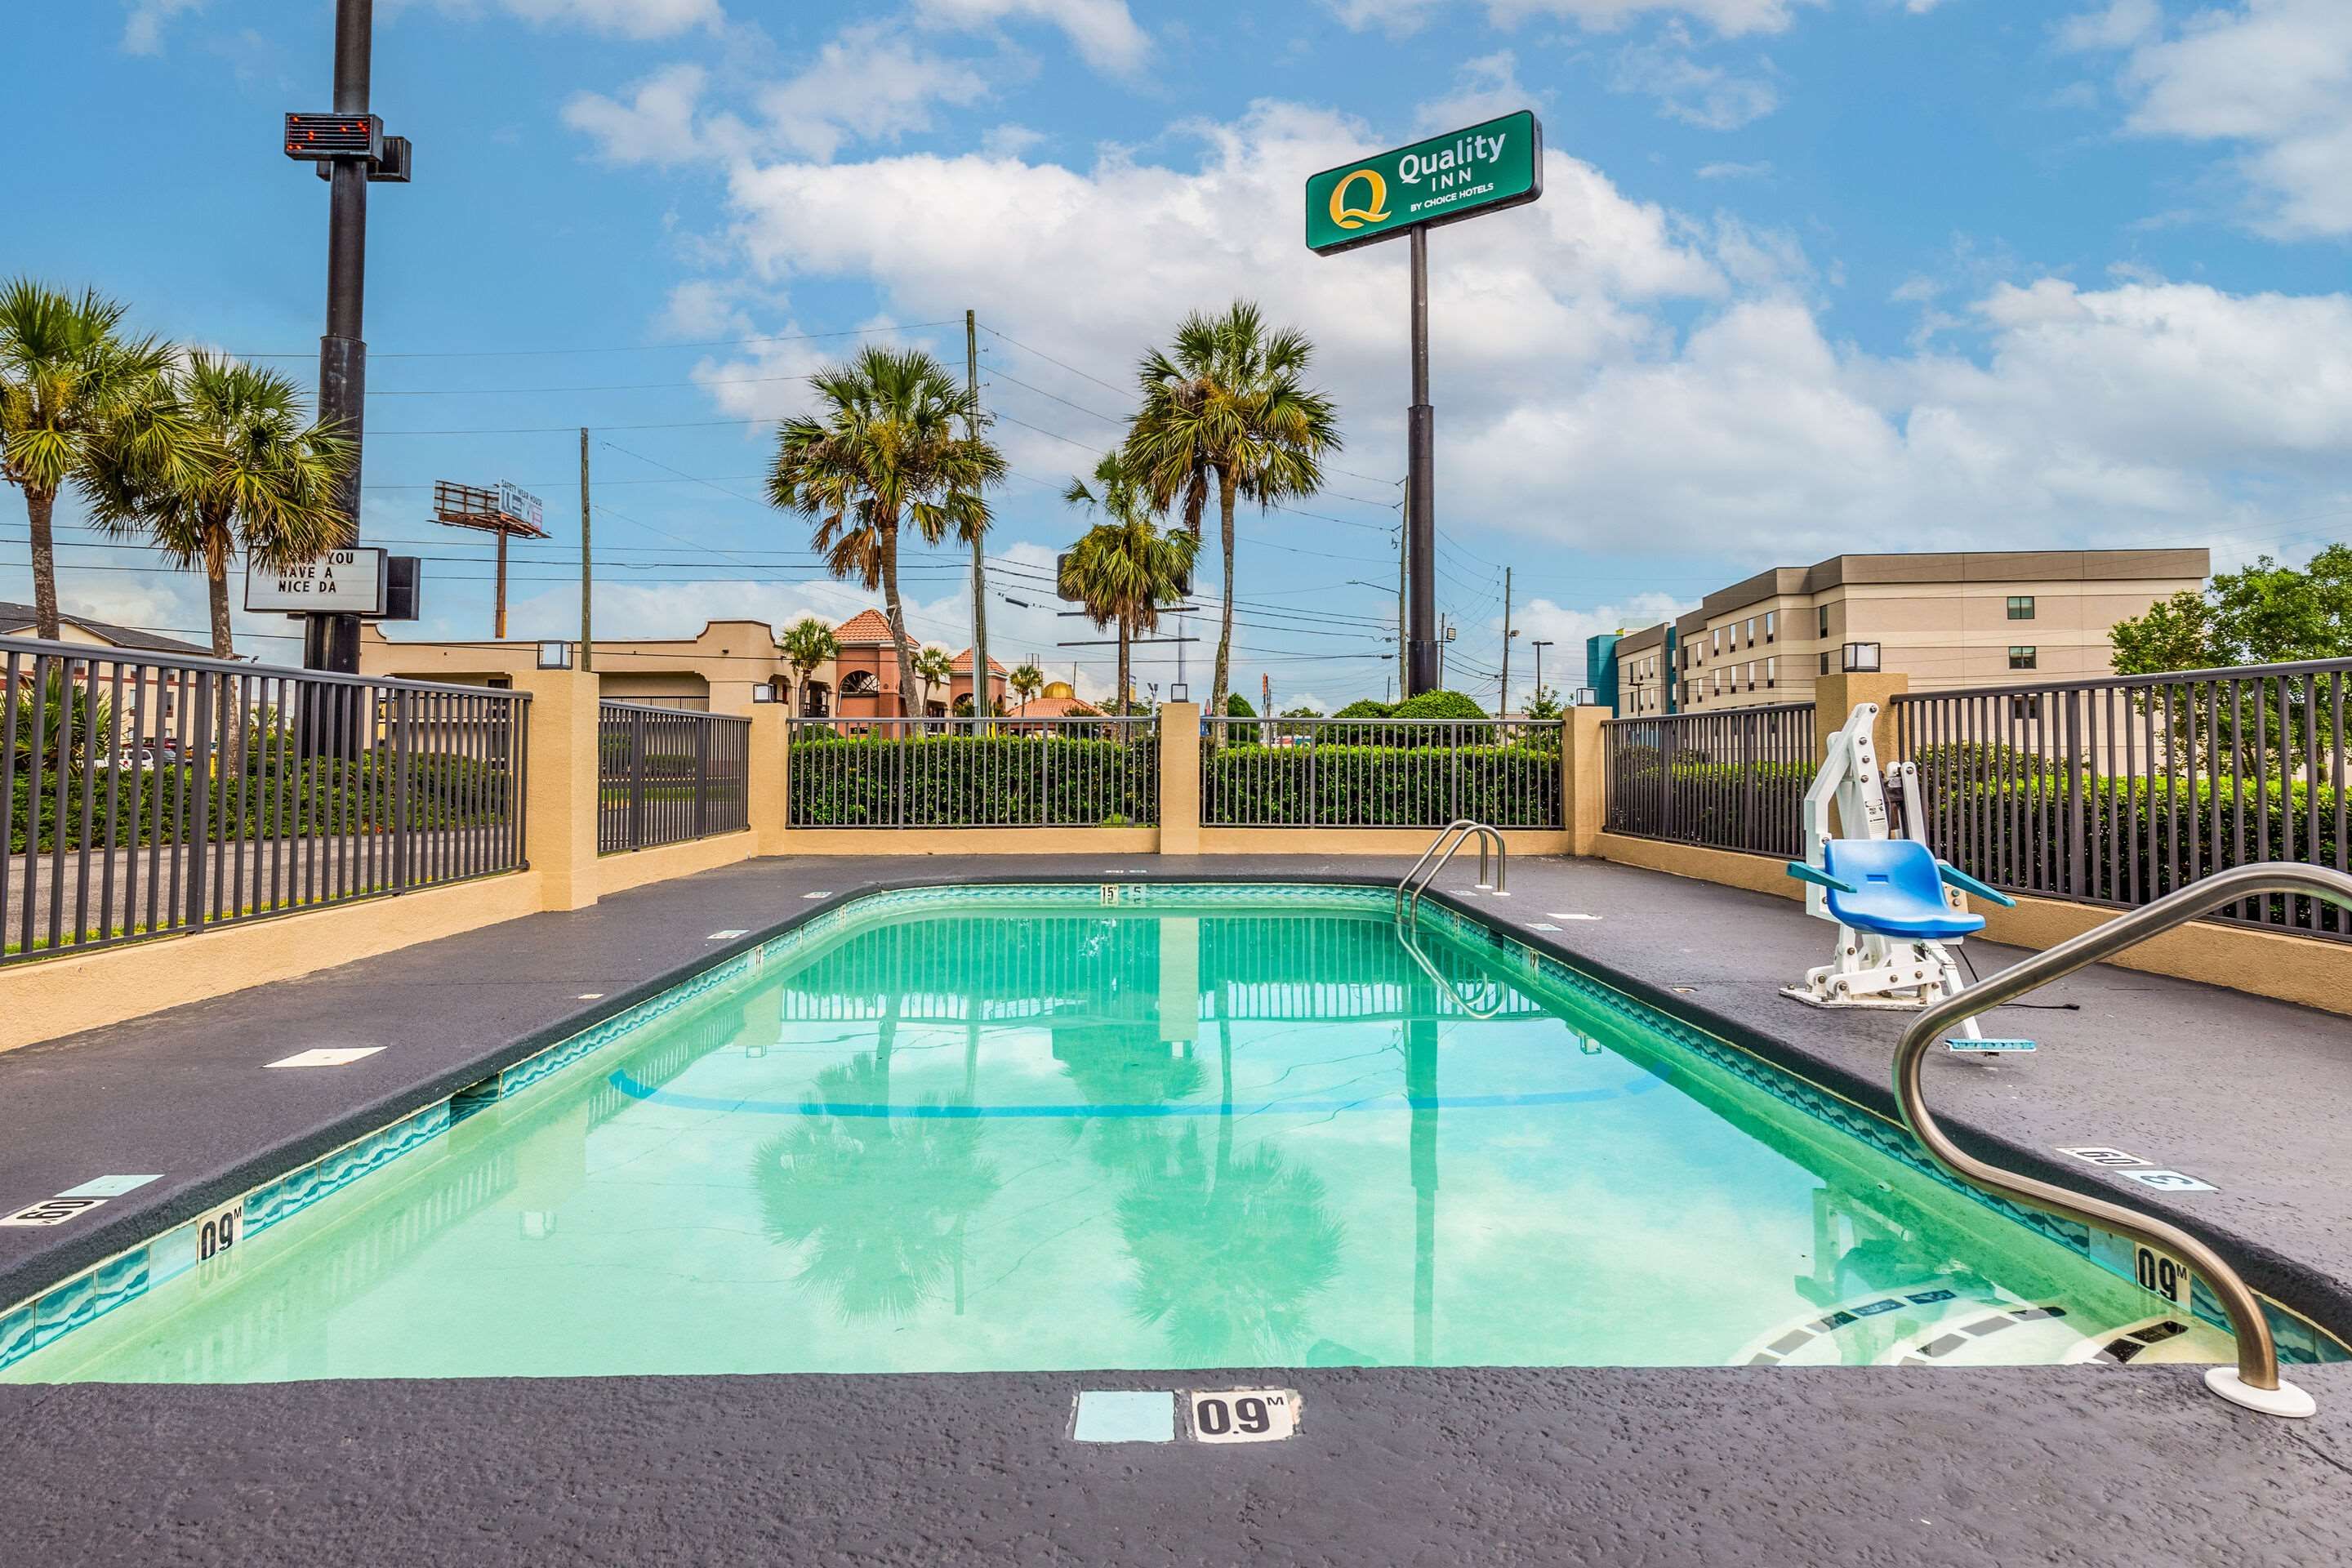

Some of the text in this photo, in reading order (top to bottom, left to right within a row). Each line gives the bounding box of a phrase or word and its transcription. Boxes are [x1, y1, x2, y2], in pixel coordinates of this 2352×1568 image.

[1398, 133, 1507, 184] Quality
[1432, 167, 1472, 192] INN
[1329, 169, 1392, 229] Q
[1410, 183, 1494, 212] BY CHOICE HOTELS
[327, 552, 354, 564] YOU
[325, 567, 332, 578] A
[278, 581, 336, 593] NICE DA
